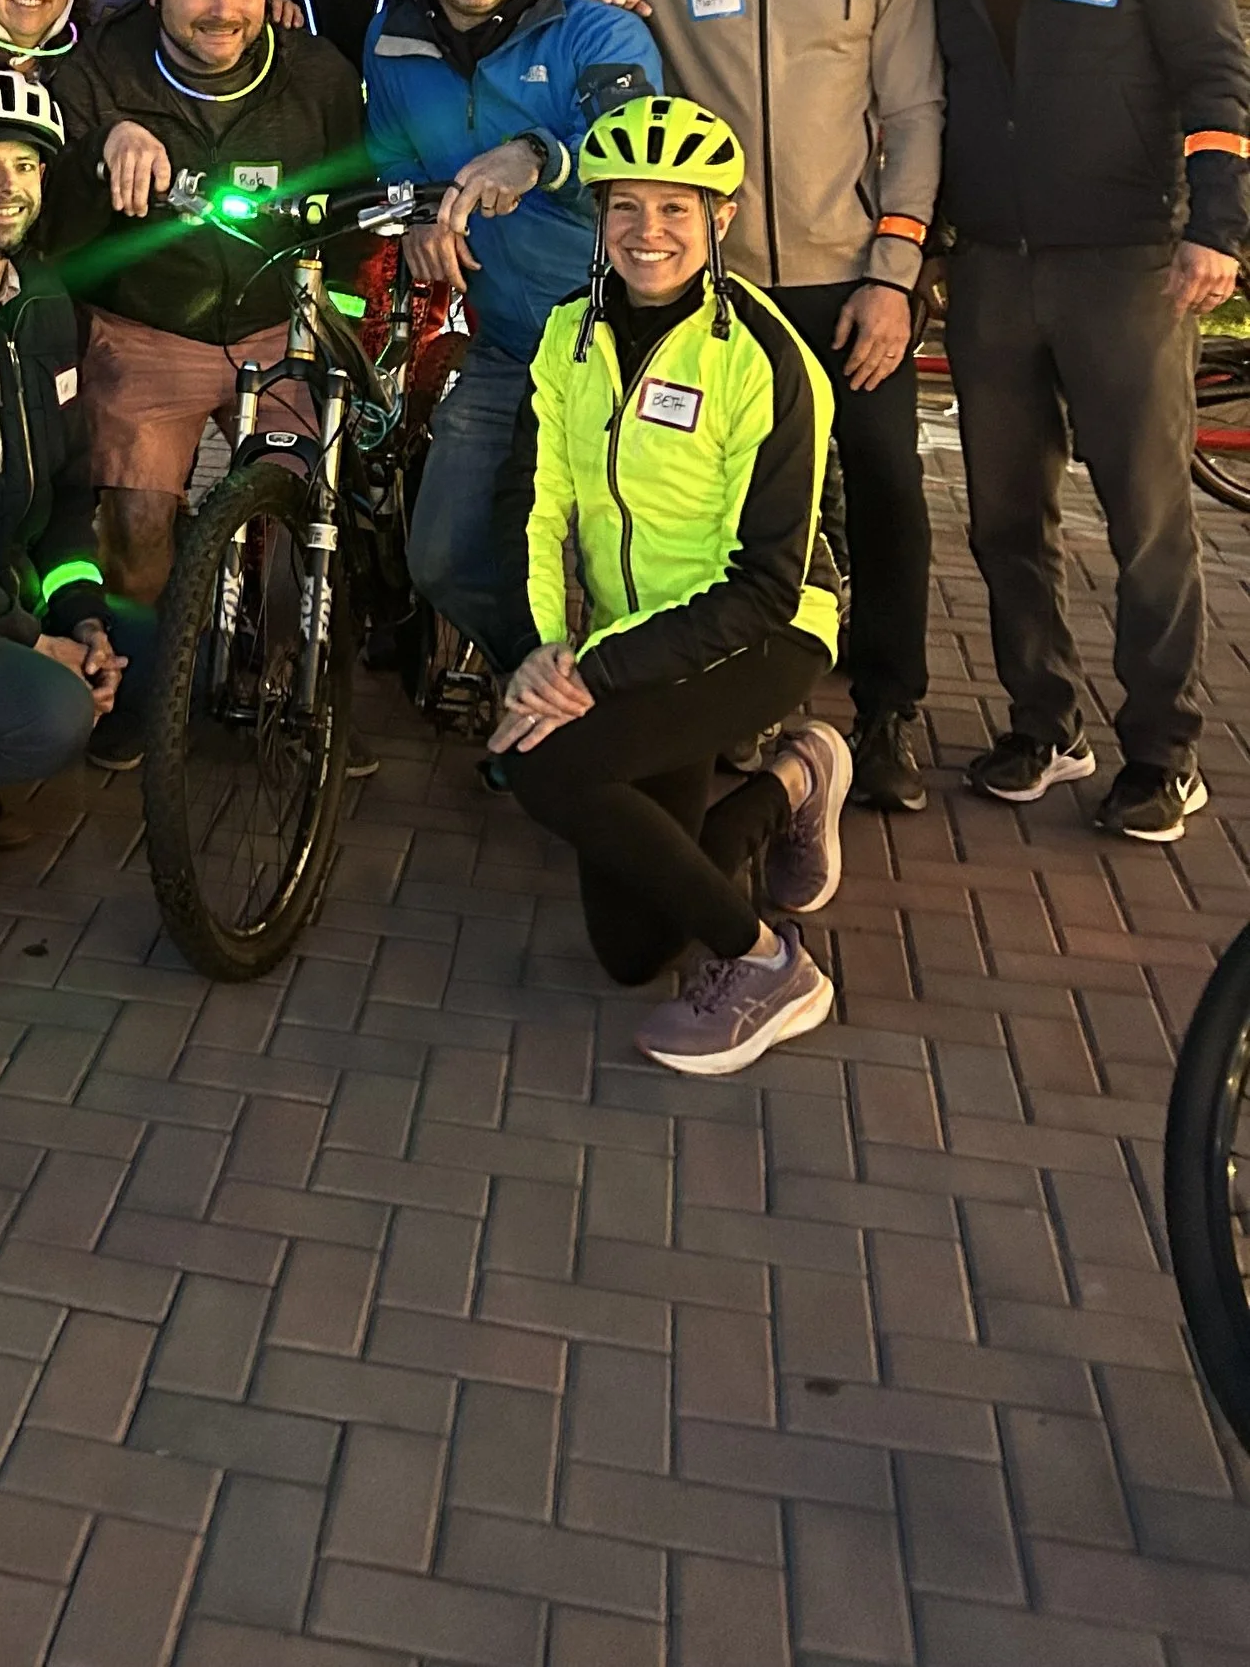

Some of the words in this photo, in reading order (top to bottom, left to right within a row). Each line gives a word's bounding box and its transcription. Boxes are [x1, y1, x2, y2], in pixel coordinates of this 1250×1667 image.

[239, 171, 265, 186] Rob
[652, 391, 686, 411] BETH
[220, 566, 241, 636] FOX
[300, 575, 315, 641] FOX
[317, 576, 334, 643] FOX
